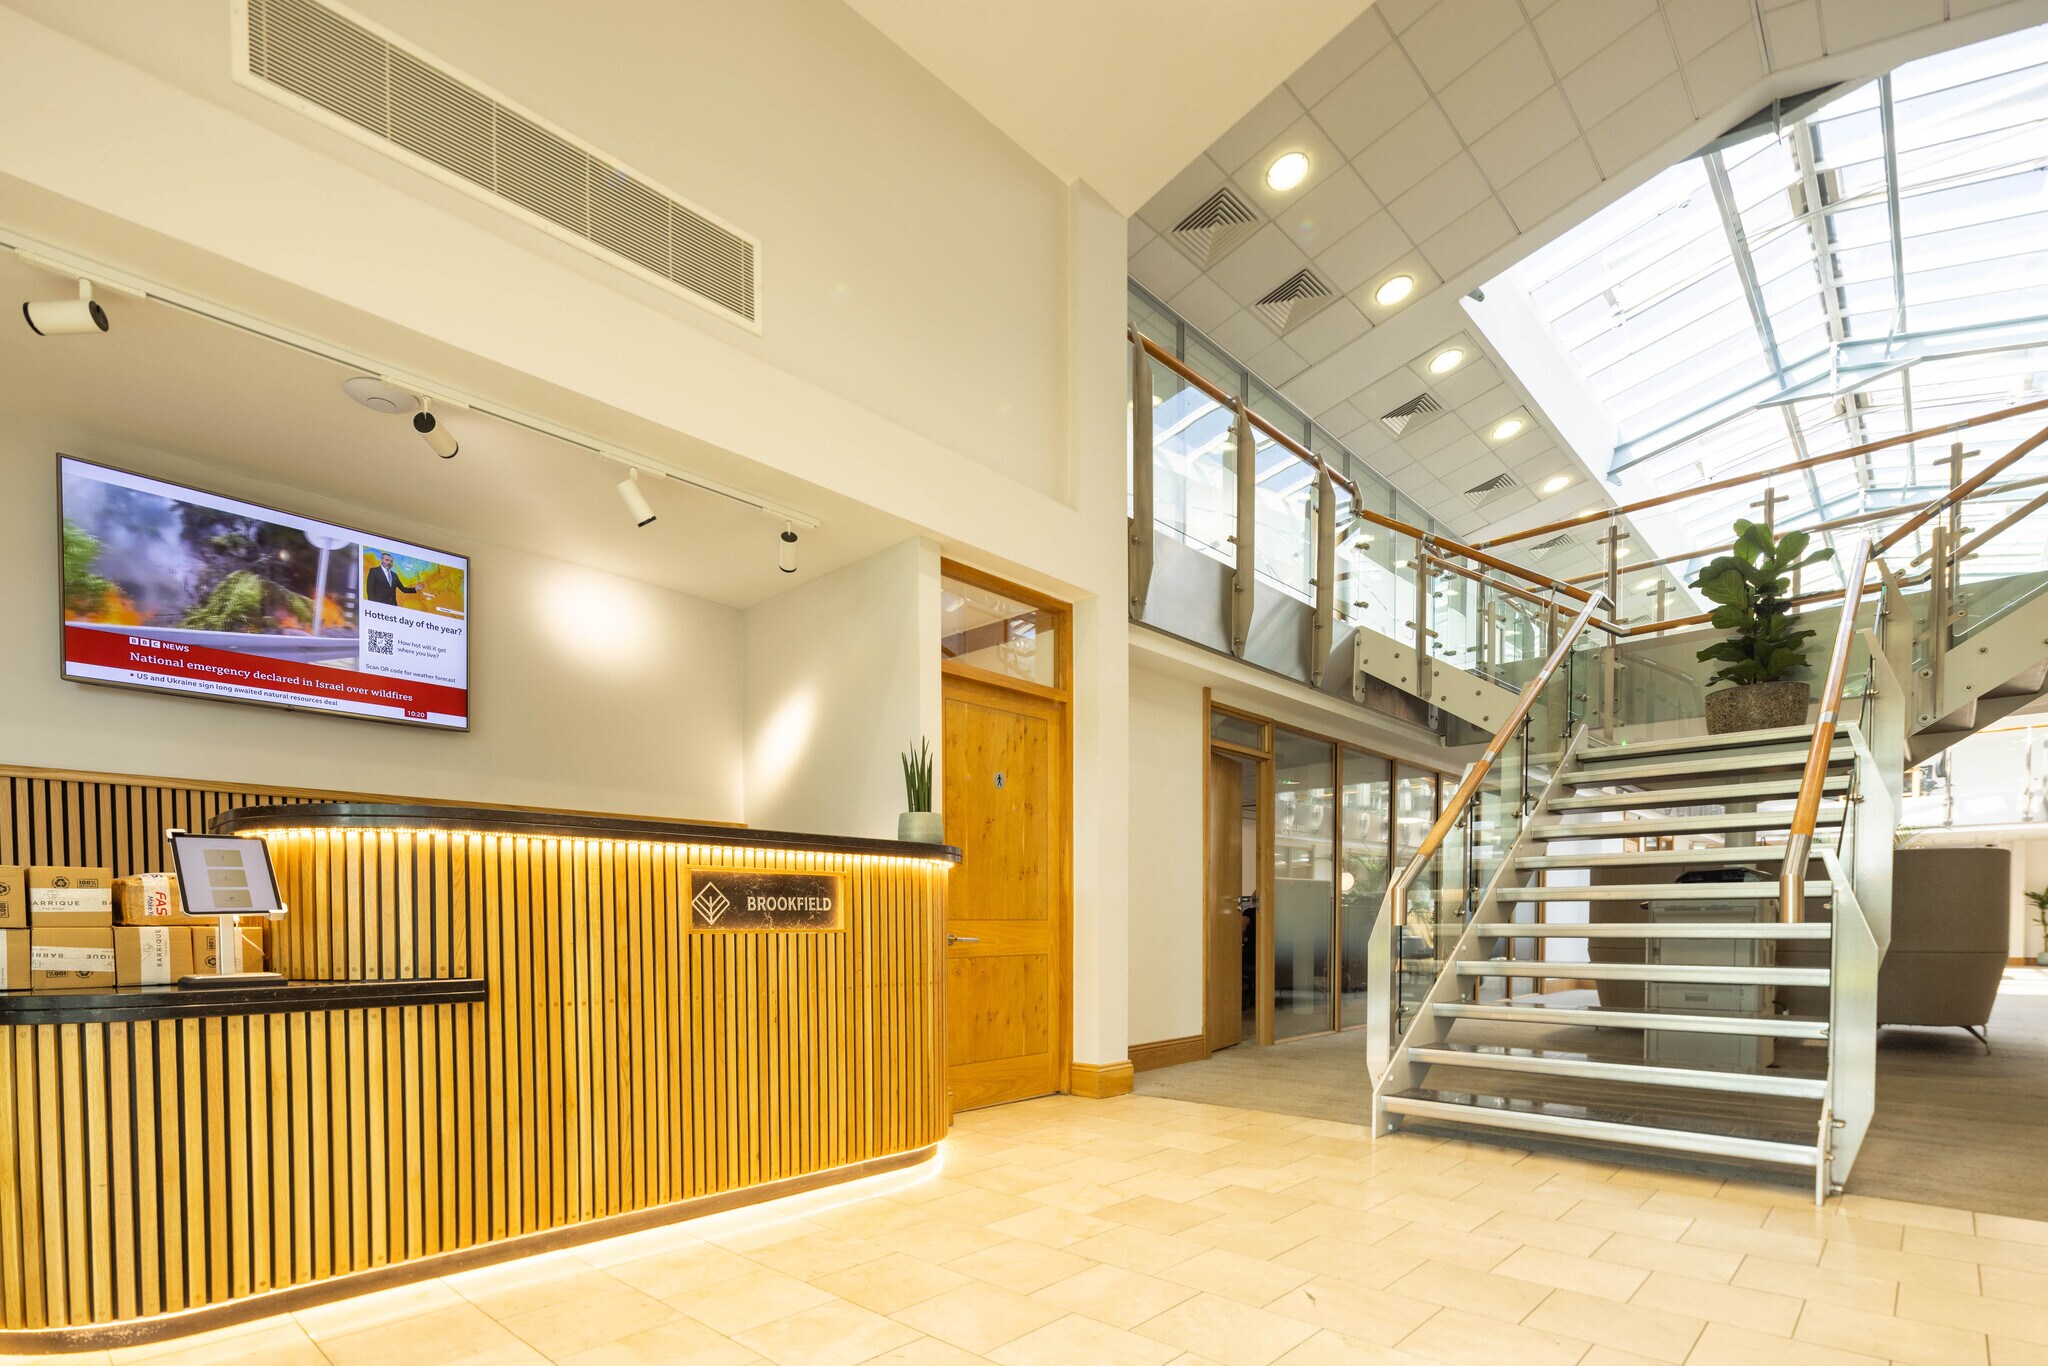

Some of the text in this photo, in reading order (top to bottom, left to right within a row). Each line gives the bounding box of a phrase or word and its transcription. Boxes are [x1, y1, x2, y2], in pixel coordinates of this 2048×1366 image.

[364, 609, 462, 636] Hottest day of the year?
[162, 642, 190, 653] NEWS
[397, 639, 411, 647] How
[411, 641, 421, 649] hot
[422, 643, 432, 651] will
[397, 647, 415, 655] where
[427, 651, 440, 660] live?
[129, 651, 413, 702] National emergency declared in Israel over wildfires
[365, 663, 380, 671] Scan
[390, 668, 404, 676] code
[413, 671, 434, 680] weather
[434, 675, 456, 684] forecast
[150, 674, 165, 683] and
[166, 676, 197, 688] Ukraine
[198, 681, 215, 690] sign
[215, 684, 233, 693] long
[234, 686, 262, 696] awaited
[263, 689, 289, 699] natural
[290, 694, 323, 704] resources
[324, 698, 338, 706] deal
[407, 710, 425, 718] 10:20
[747, 896, 832, 912] BROOKFIELD
[154, 929, 163, 968] BARRIQUE
